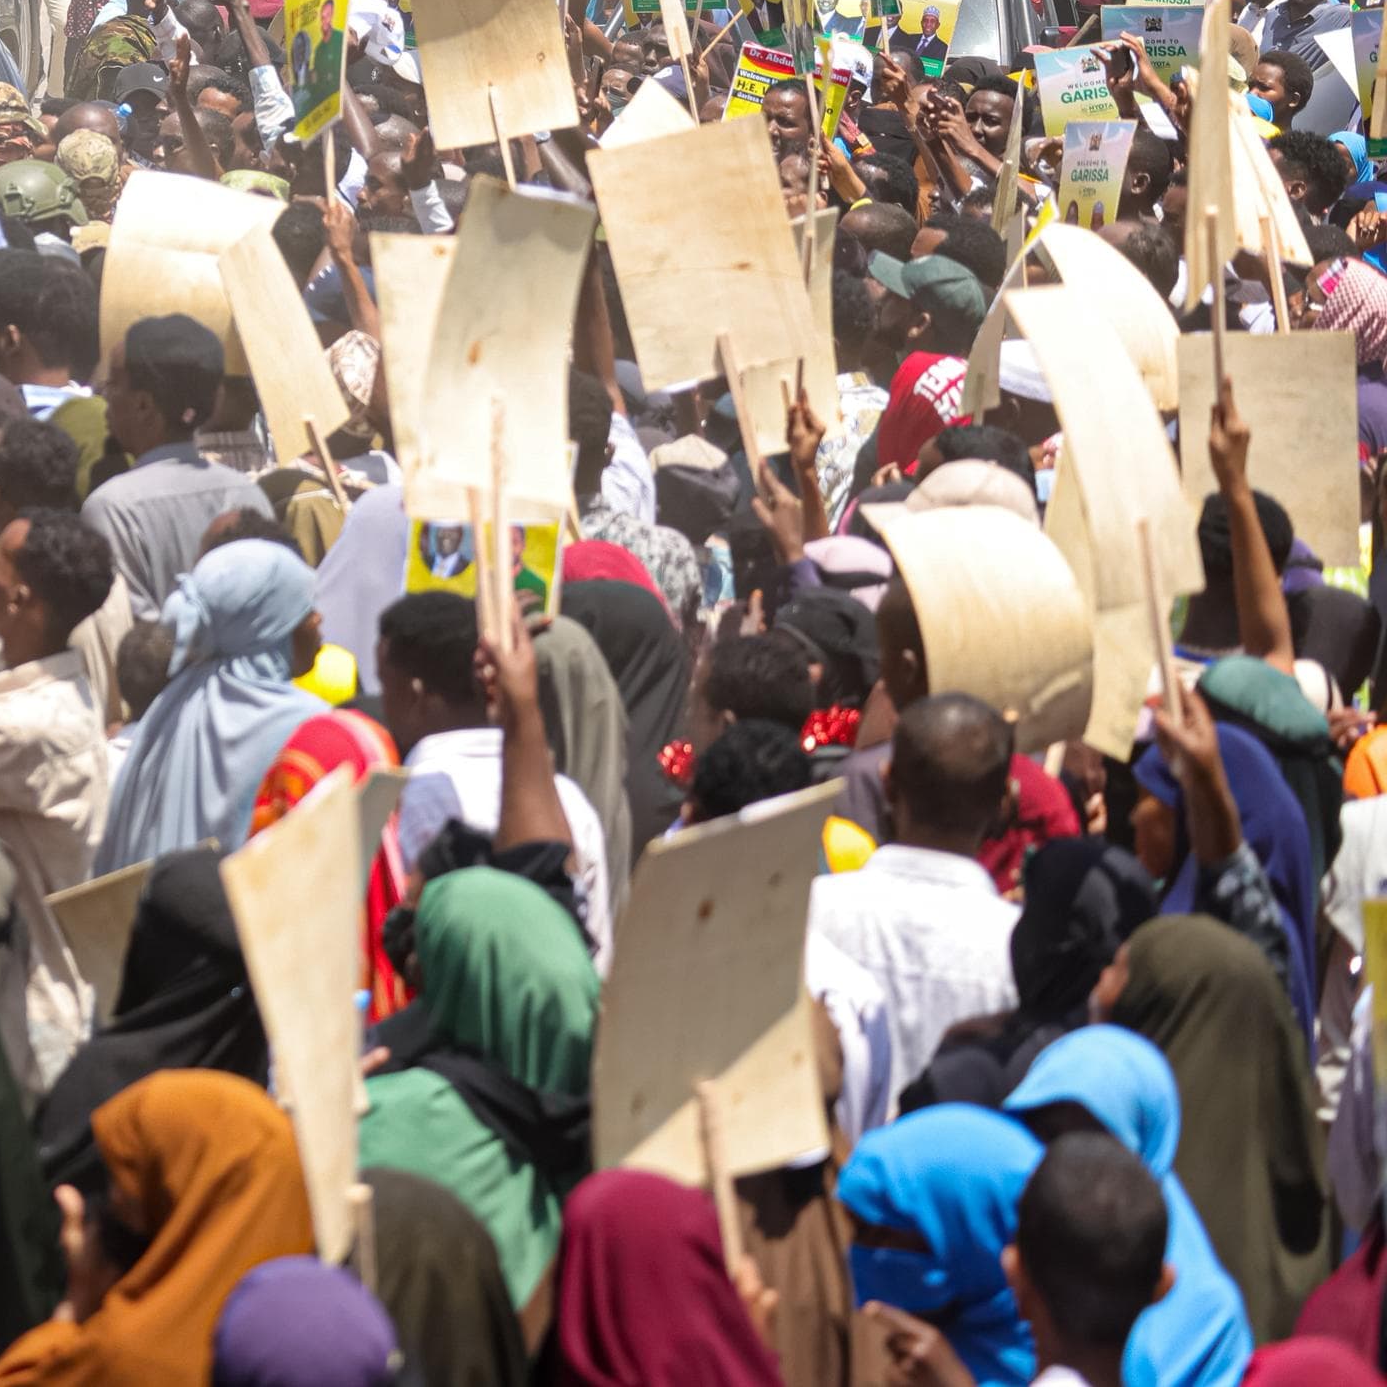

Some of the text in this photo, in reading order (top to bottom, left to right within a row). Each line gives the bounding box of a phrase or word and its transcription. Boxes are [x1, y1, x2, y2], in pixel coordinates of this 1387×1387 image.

[749, 48, 764, 59] Dr.
[739, 70, 771, 84] Welcome
[1067, 79, 1106, 89] WELCOME
[737, 79, 758, 93] H.E.
[1070, 168, 1109, 182] GARISSA
